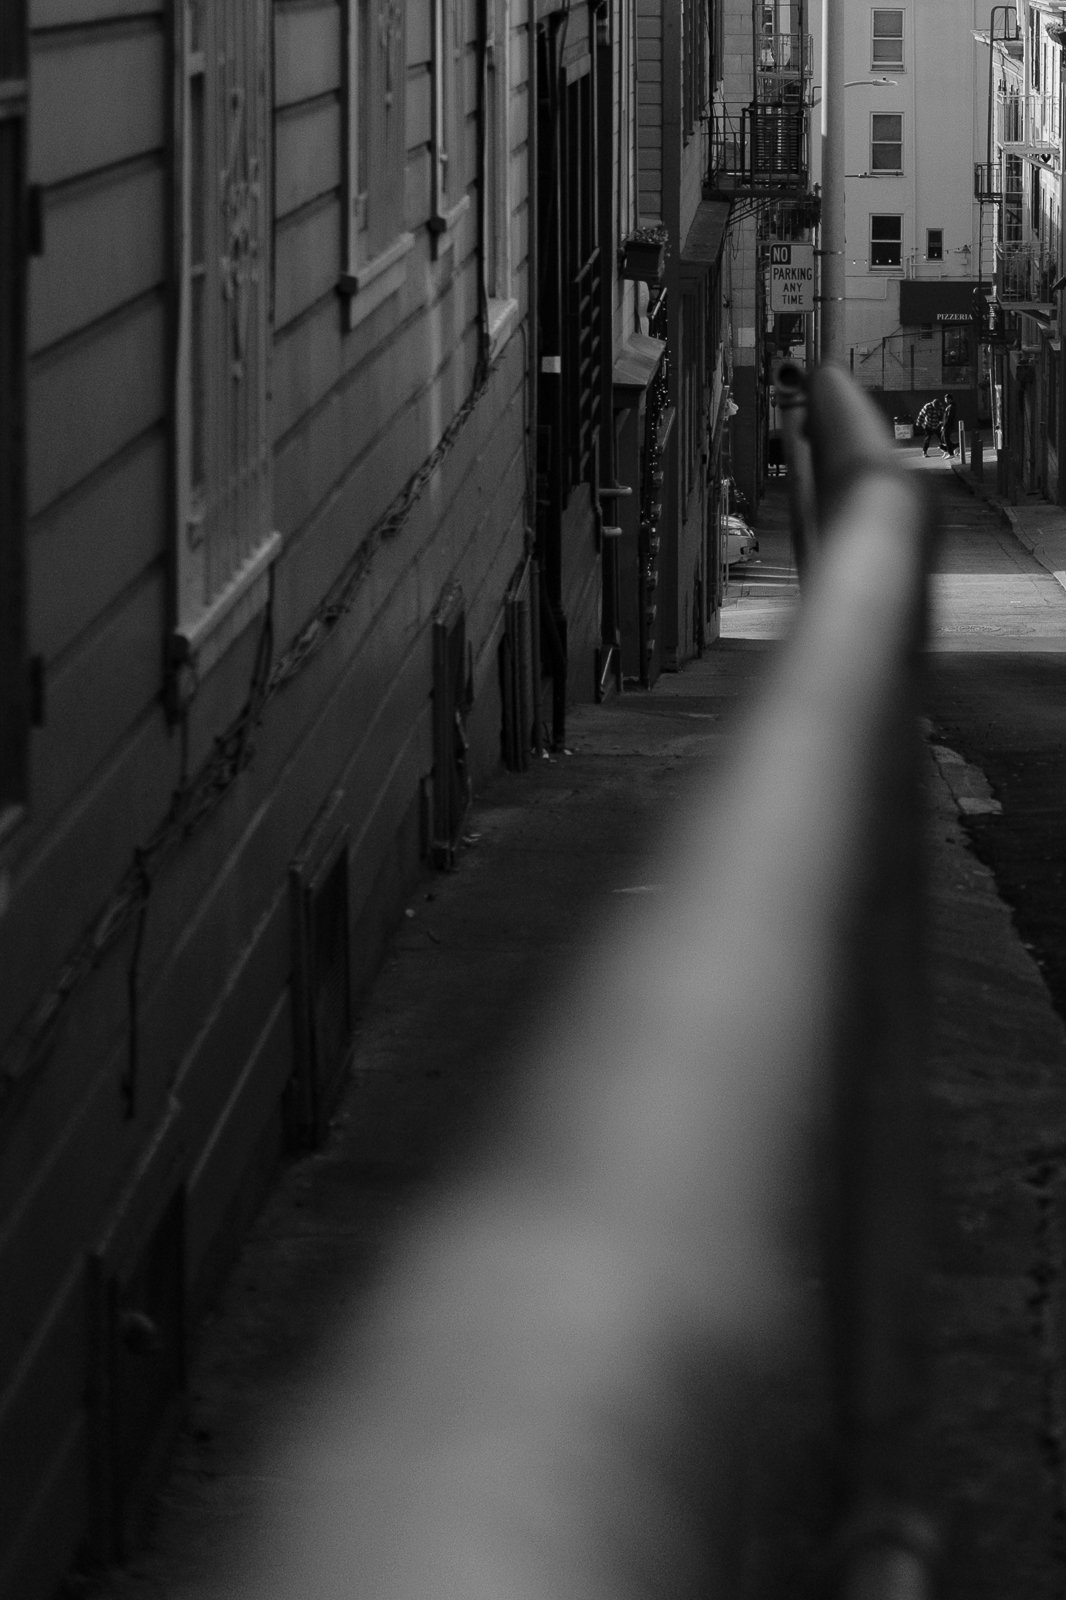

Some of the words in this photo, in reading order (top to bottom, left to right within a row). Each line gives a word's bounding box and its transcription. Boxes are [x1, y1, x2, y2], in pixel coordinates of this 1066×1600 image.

[773, 246, 788, 263] NO
[773, 267, 813, 281] PARKING
[783, 282, 803, 293] ANY
[782, 294, 804, 305] TIME
[936, 313, 973, 321] PIZZERIA
